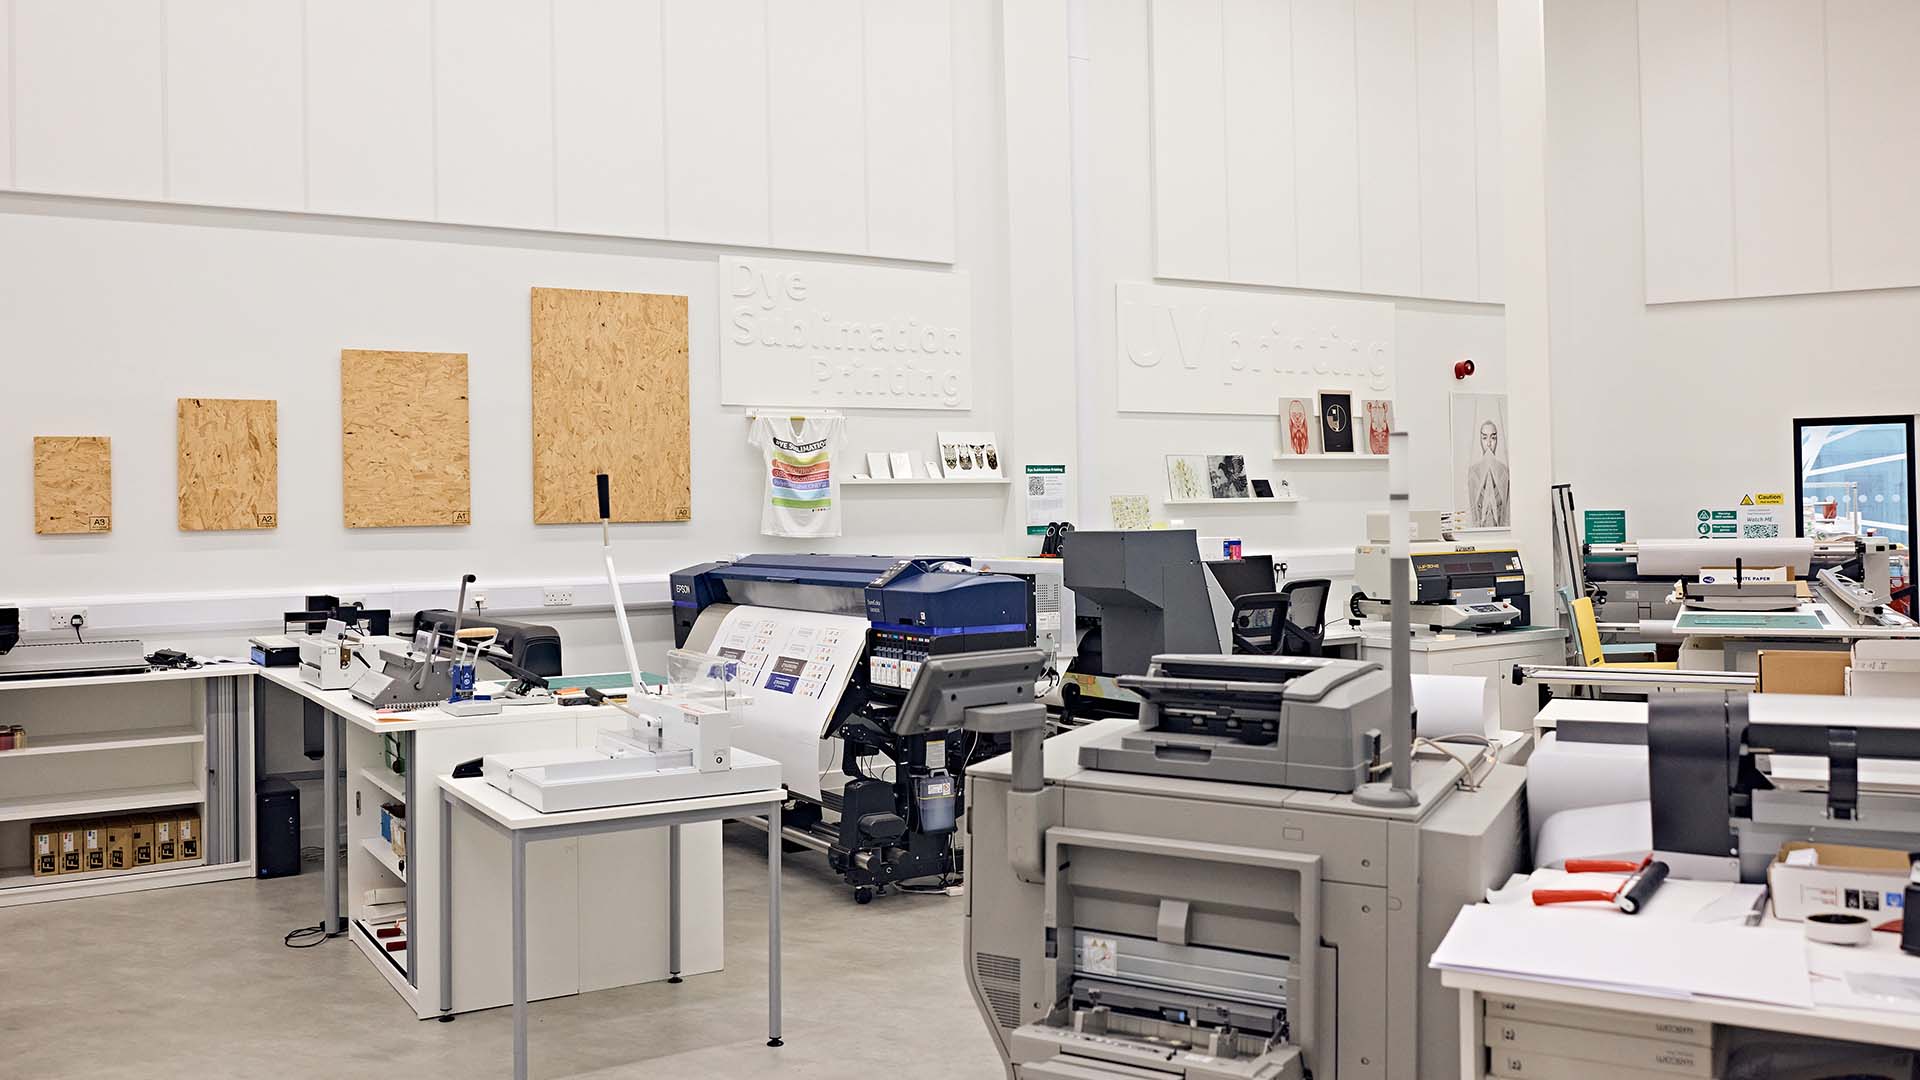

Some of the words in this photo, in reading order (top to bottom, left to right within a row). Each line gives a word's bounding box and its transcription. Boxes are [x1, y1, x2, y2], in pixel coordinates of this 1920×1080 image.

[731, 264, 807, 310] Dye
[732, 304, 962, 356] Sublimation
[1125, 299, 1207, 370] UV
[1223, 319, 1389, 391] printing
[809, 356, 962, 407] Printing
[94, 518, 105, 526] A3
[261, 515, 273, 523] A2
[676, 584, 691, 594] EPSON
